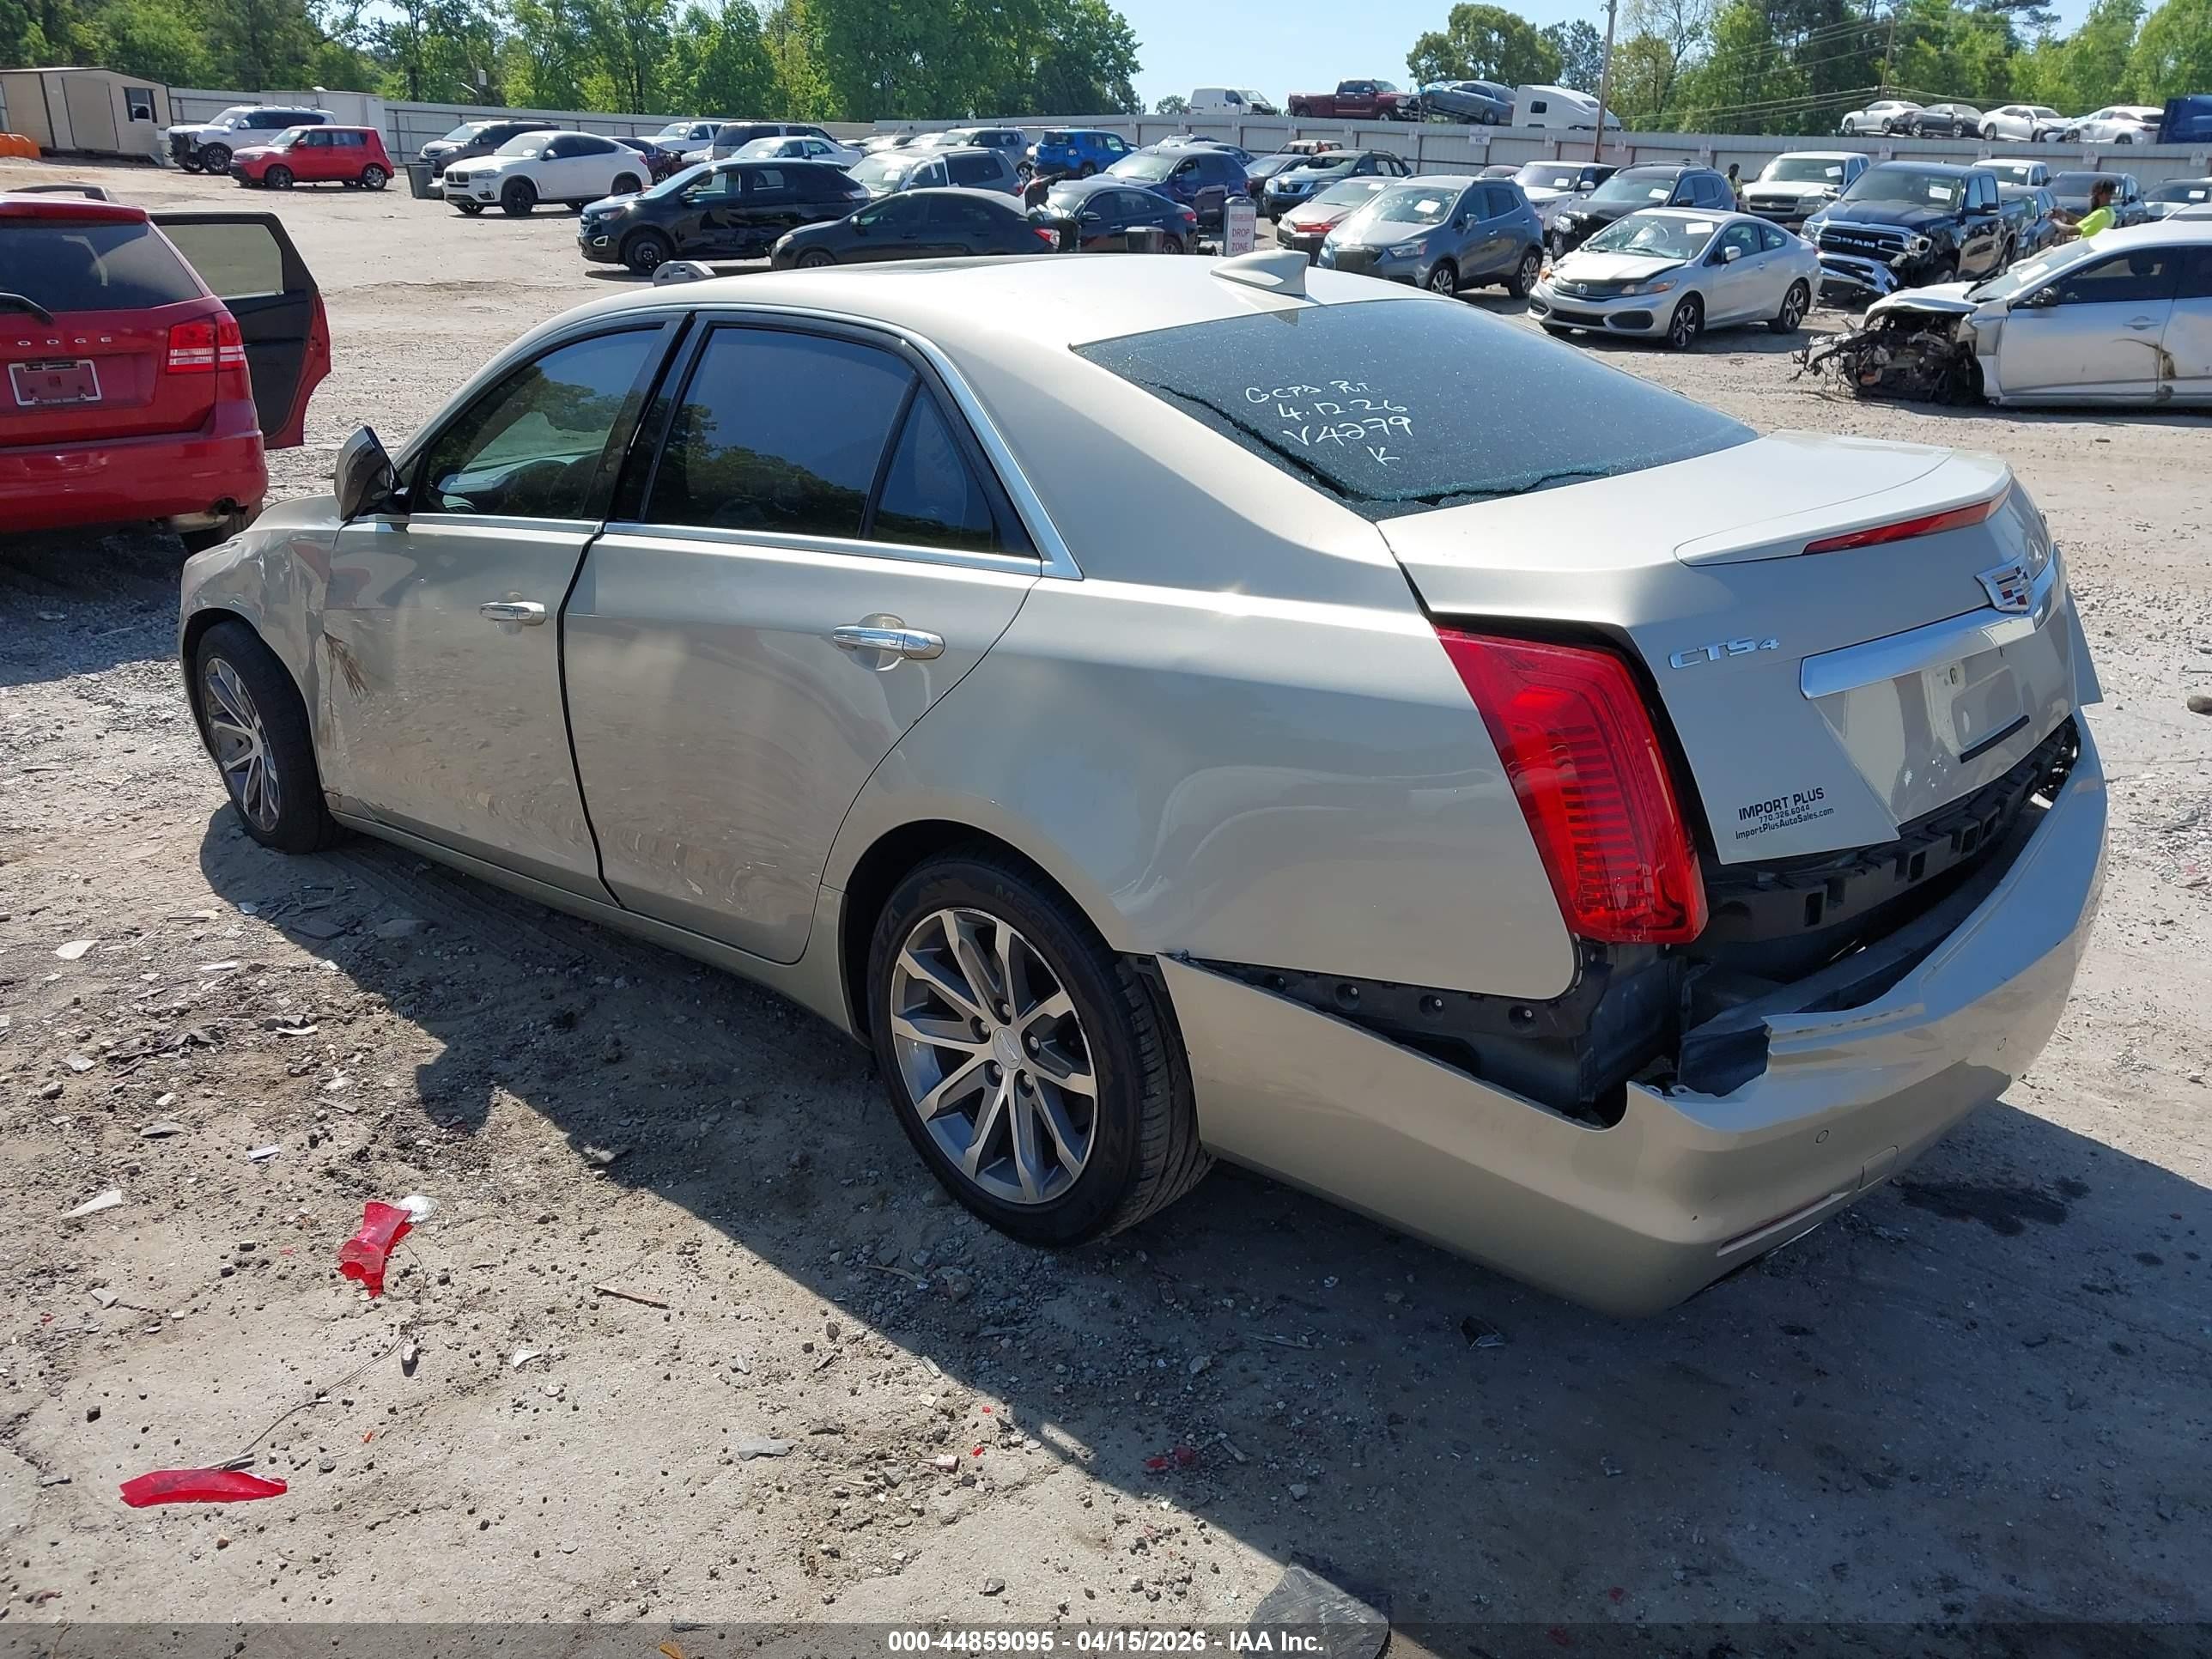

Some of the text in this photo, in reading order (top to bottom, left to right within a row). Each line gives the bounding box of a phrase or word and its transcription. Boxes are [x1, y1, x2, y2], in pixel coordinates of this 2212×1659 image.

[1231, 228, 1250, 238] DROP
[1231, 241, 1249, 252] ZONE
[1842, 237, 1875, 248] RAM
[0, 336, 112, 346] ODGE
[1738, 787, 1825, 821] IMPORT PLUS
[1735, 807, 1834, 840] ImportPlusAutoSales.com
